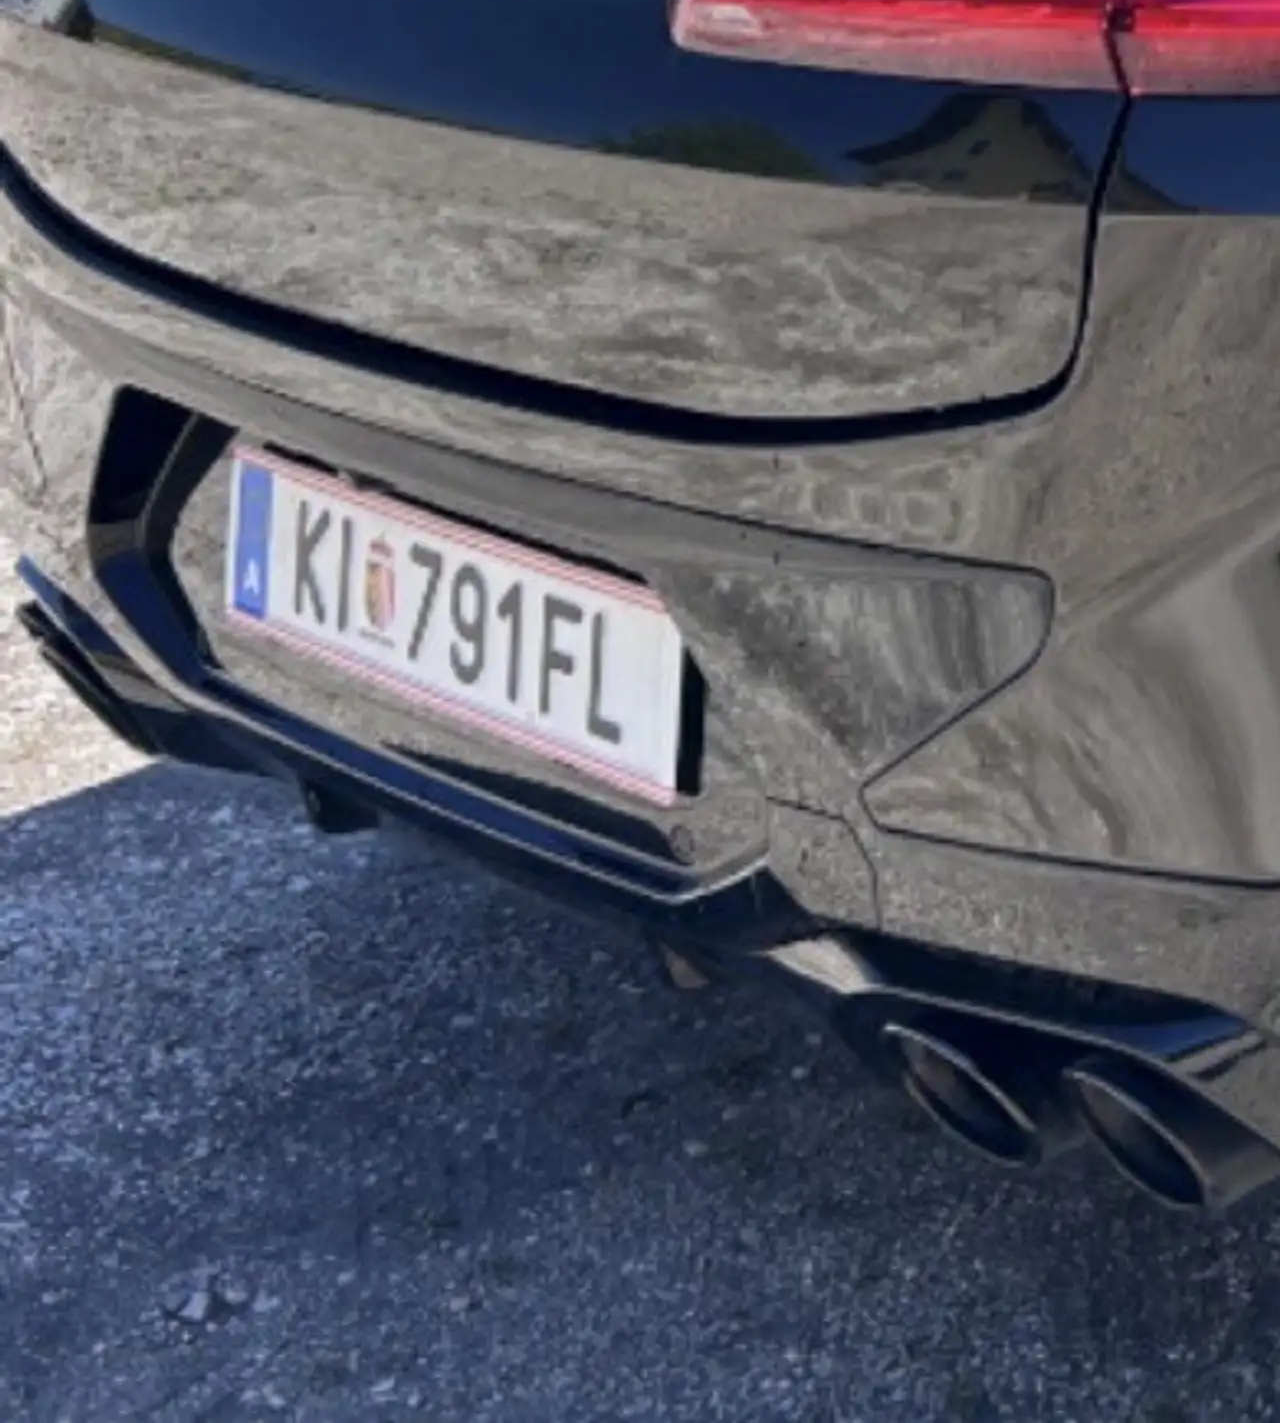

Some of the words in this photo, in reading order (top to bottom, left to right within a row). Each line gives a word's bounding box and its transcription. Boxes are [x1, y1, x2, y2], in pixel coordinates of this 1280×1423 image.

[243, 559, 261, 596] A
[294, 499, 352, 633] KI
[406, 541, 622, 746] 791FL
